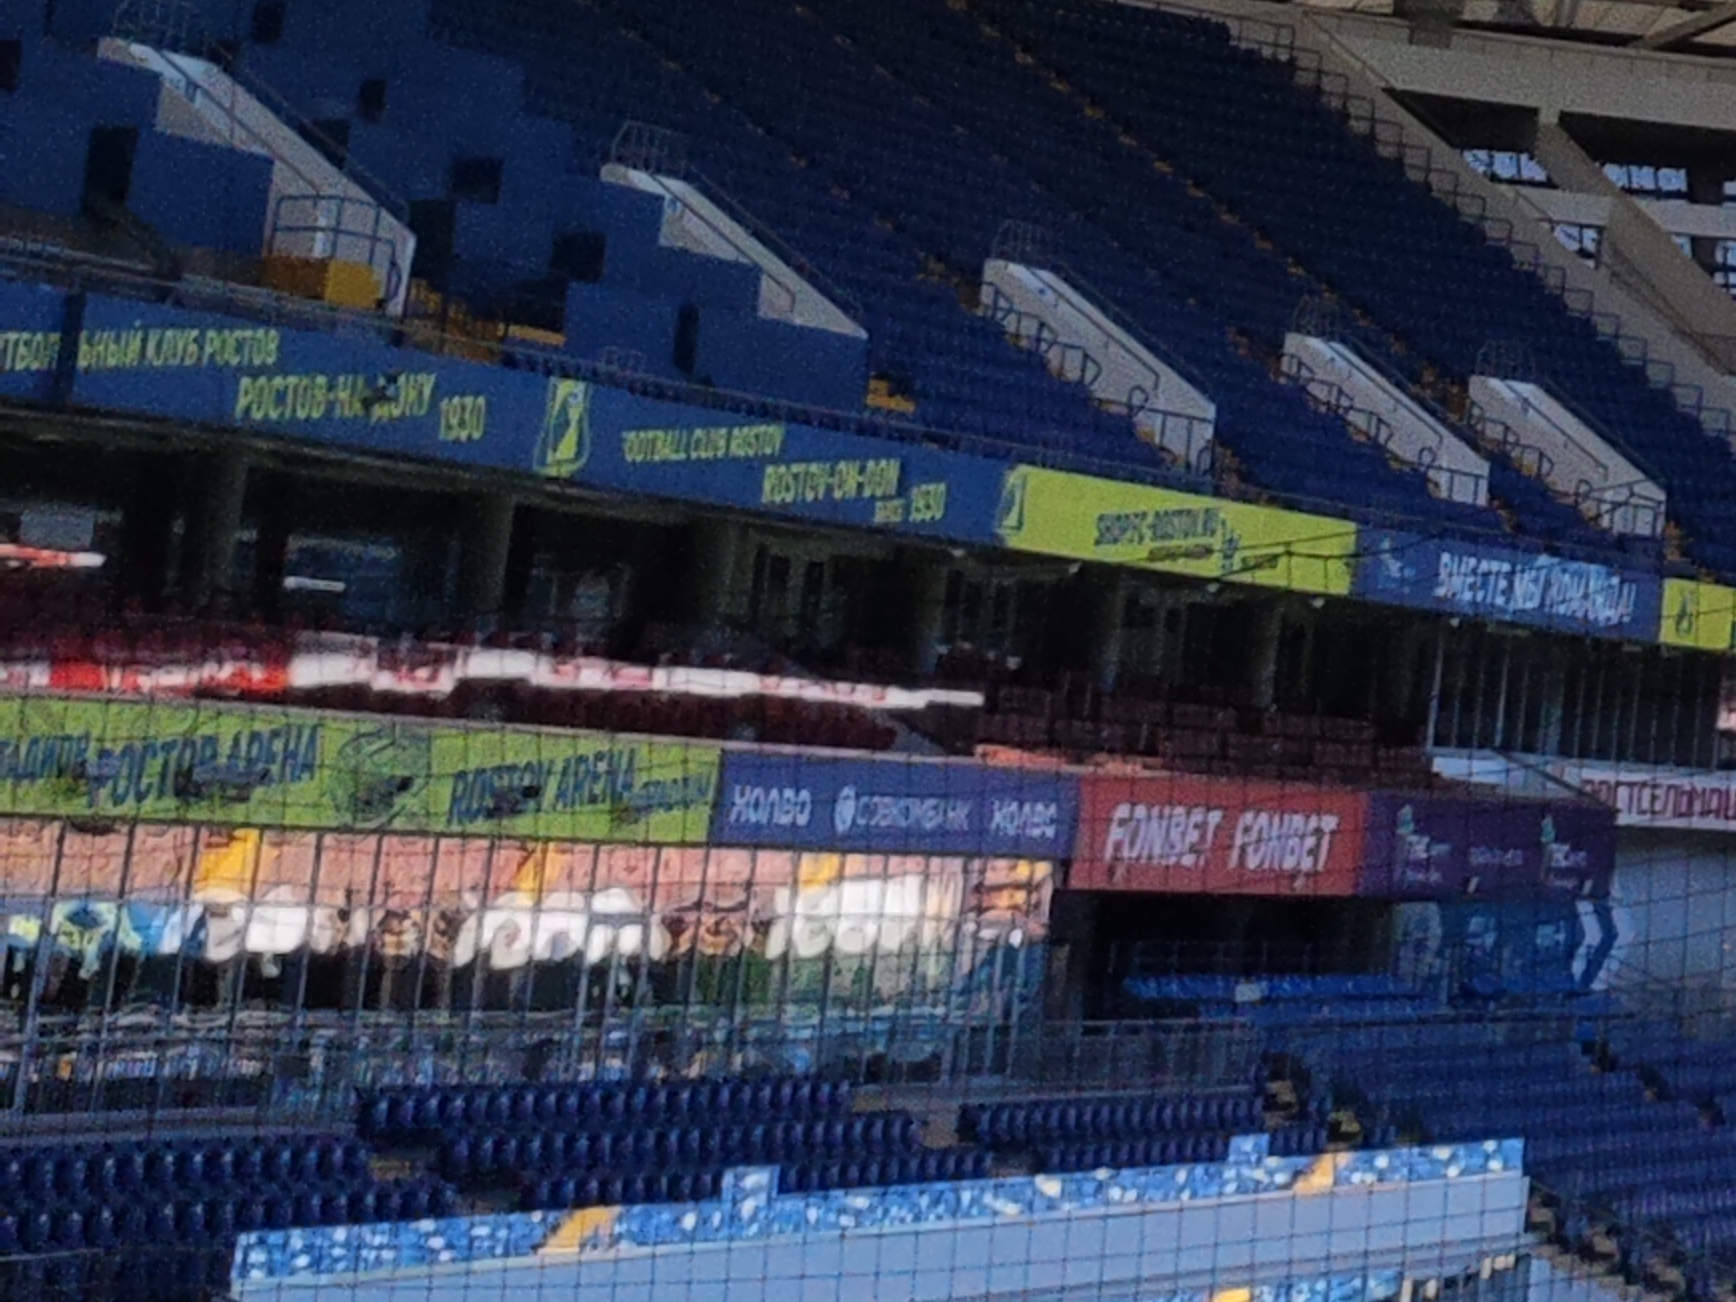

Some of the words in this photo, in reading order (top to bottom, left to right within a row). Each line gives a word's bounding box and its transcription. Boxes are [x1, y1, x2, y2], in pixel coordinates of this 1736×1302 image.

[145, 328, 200, 367] КЛУБ
[201, 328, 281, 366] РОСТОВ
[437, 394, 487, 443] 1930
[1104, 801, 1225, 869] FONBET
[1227, 808, 1340, 873] FONBET
